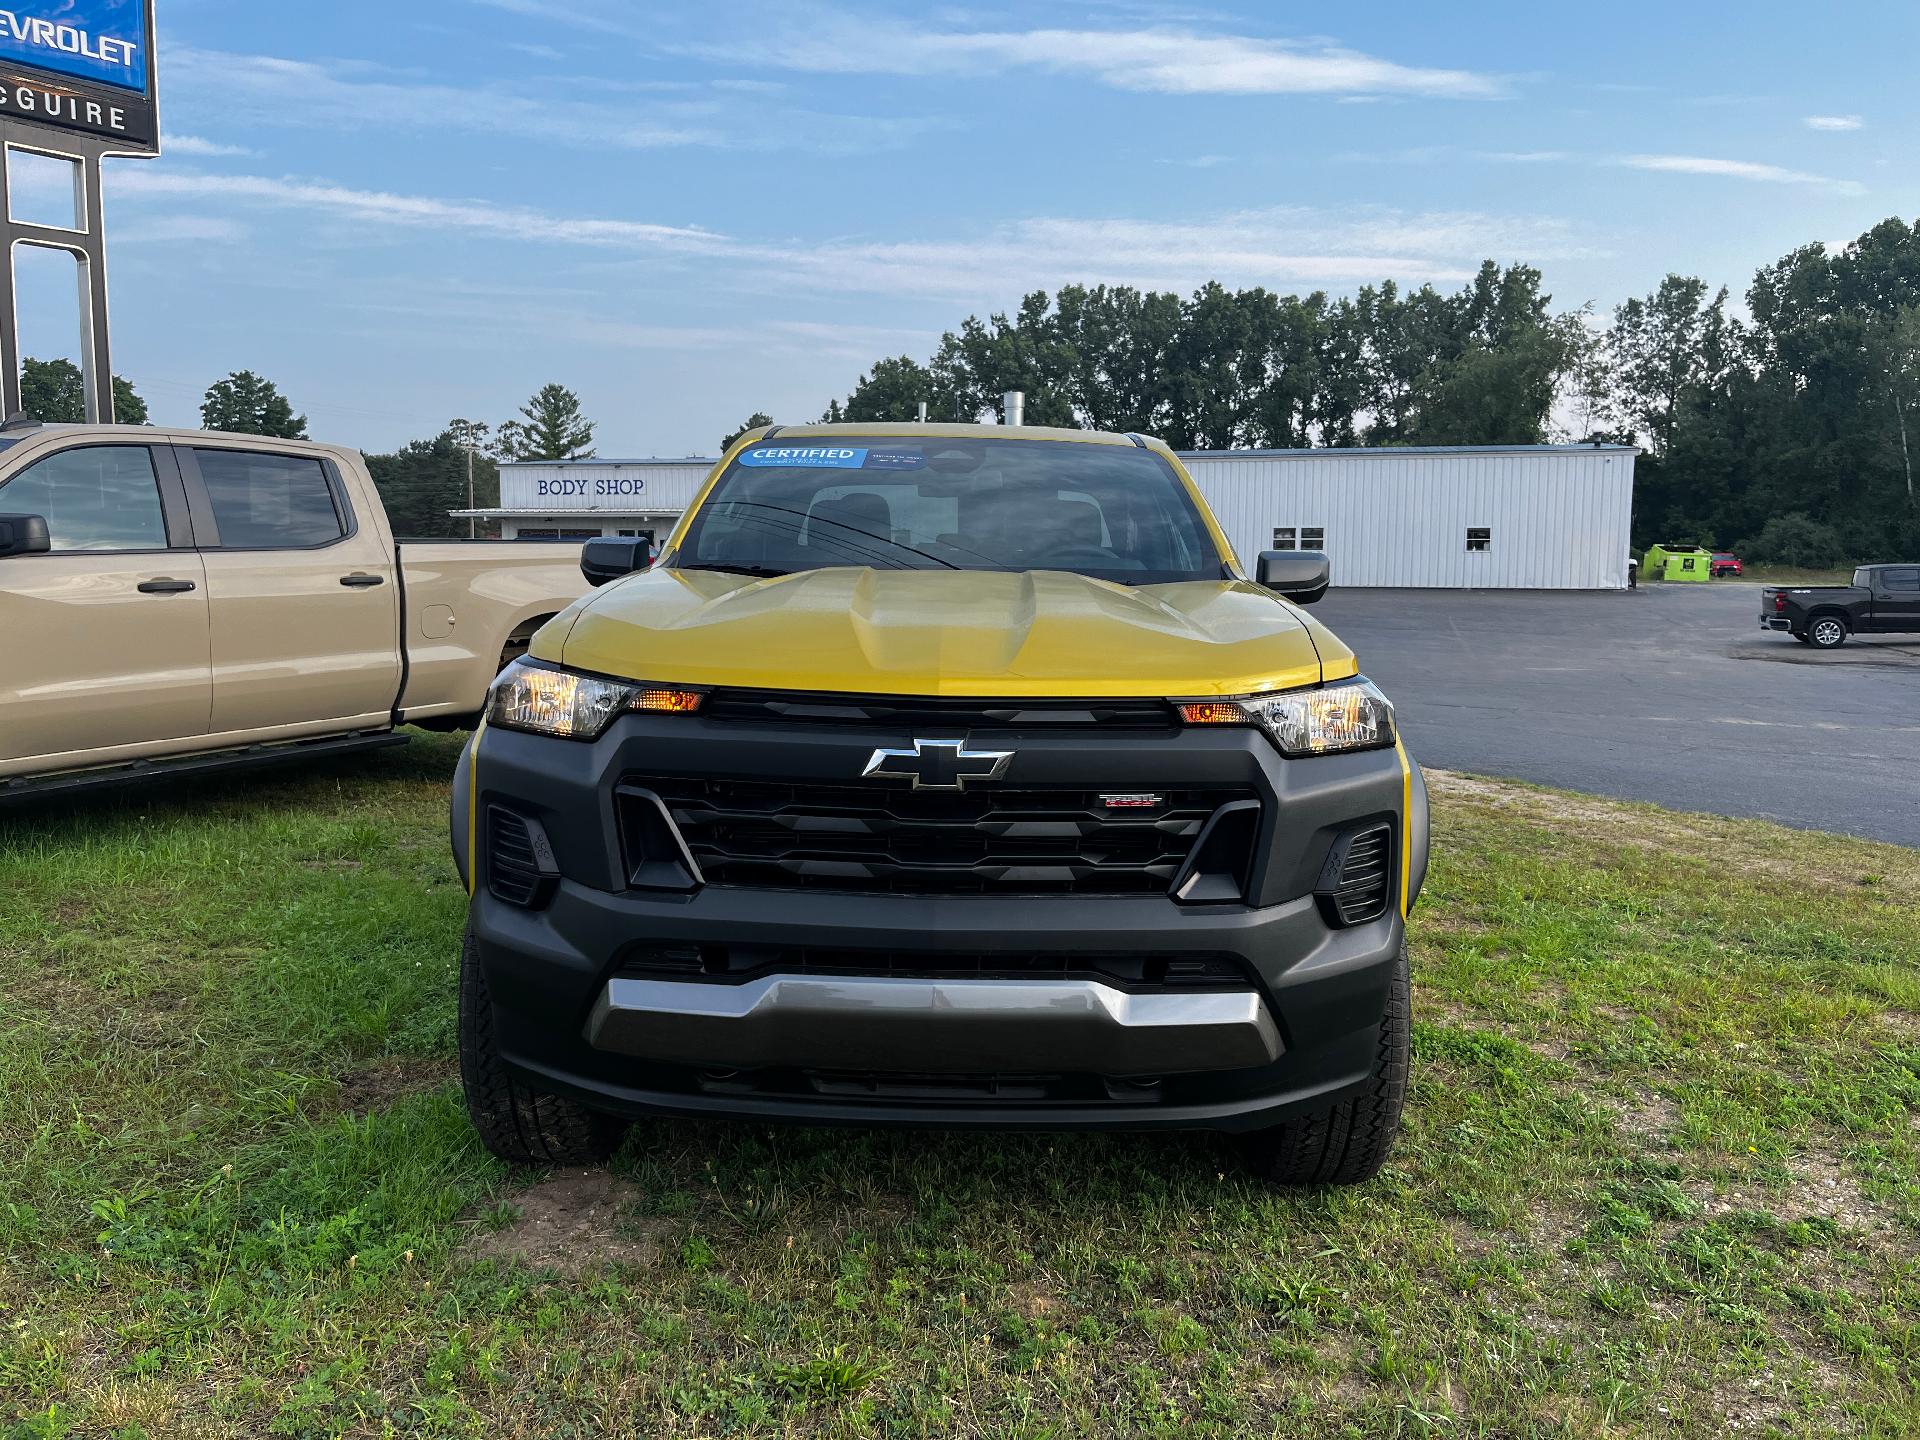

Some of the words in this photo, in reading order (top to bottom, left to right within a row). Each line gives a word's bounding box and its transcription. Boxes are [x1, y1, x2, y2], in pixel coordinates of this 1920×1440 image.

[752, 449, 854, 459] CERTIFIED
[538, 480, 588, 495] BODY
[596, 480, 644, 495] SHOP
